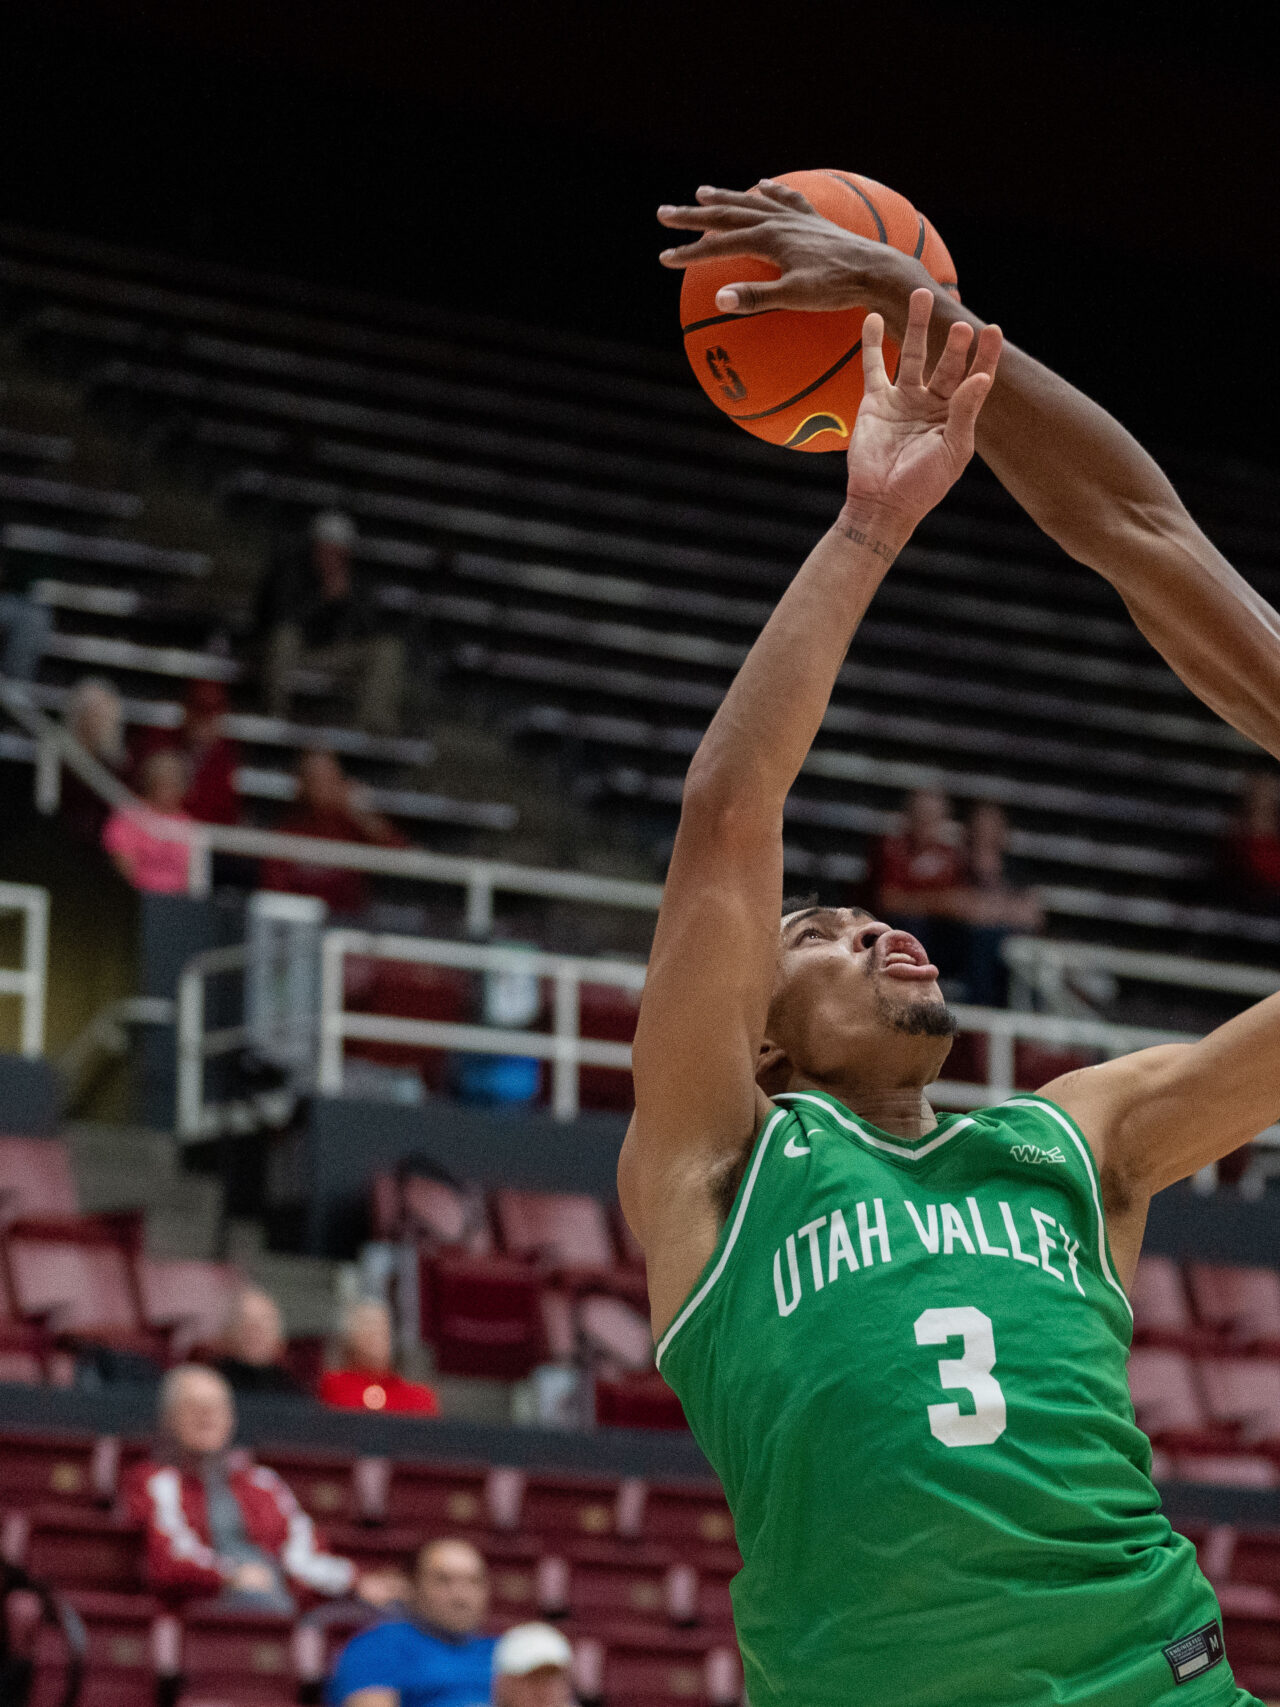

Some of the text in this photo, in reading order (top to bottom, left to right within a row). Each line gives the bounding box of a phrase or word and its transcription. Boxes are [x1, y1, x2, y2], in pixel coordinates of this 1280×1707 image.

[773, 1197, 1086, 1317] UTAH VALLEY
[914, 1306, 1007, 1448] 3
[1209, 1634, 1220, 1652] M
